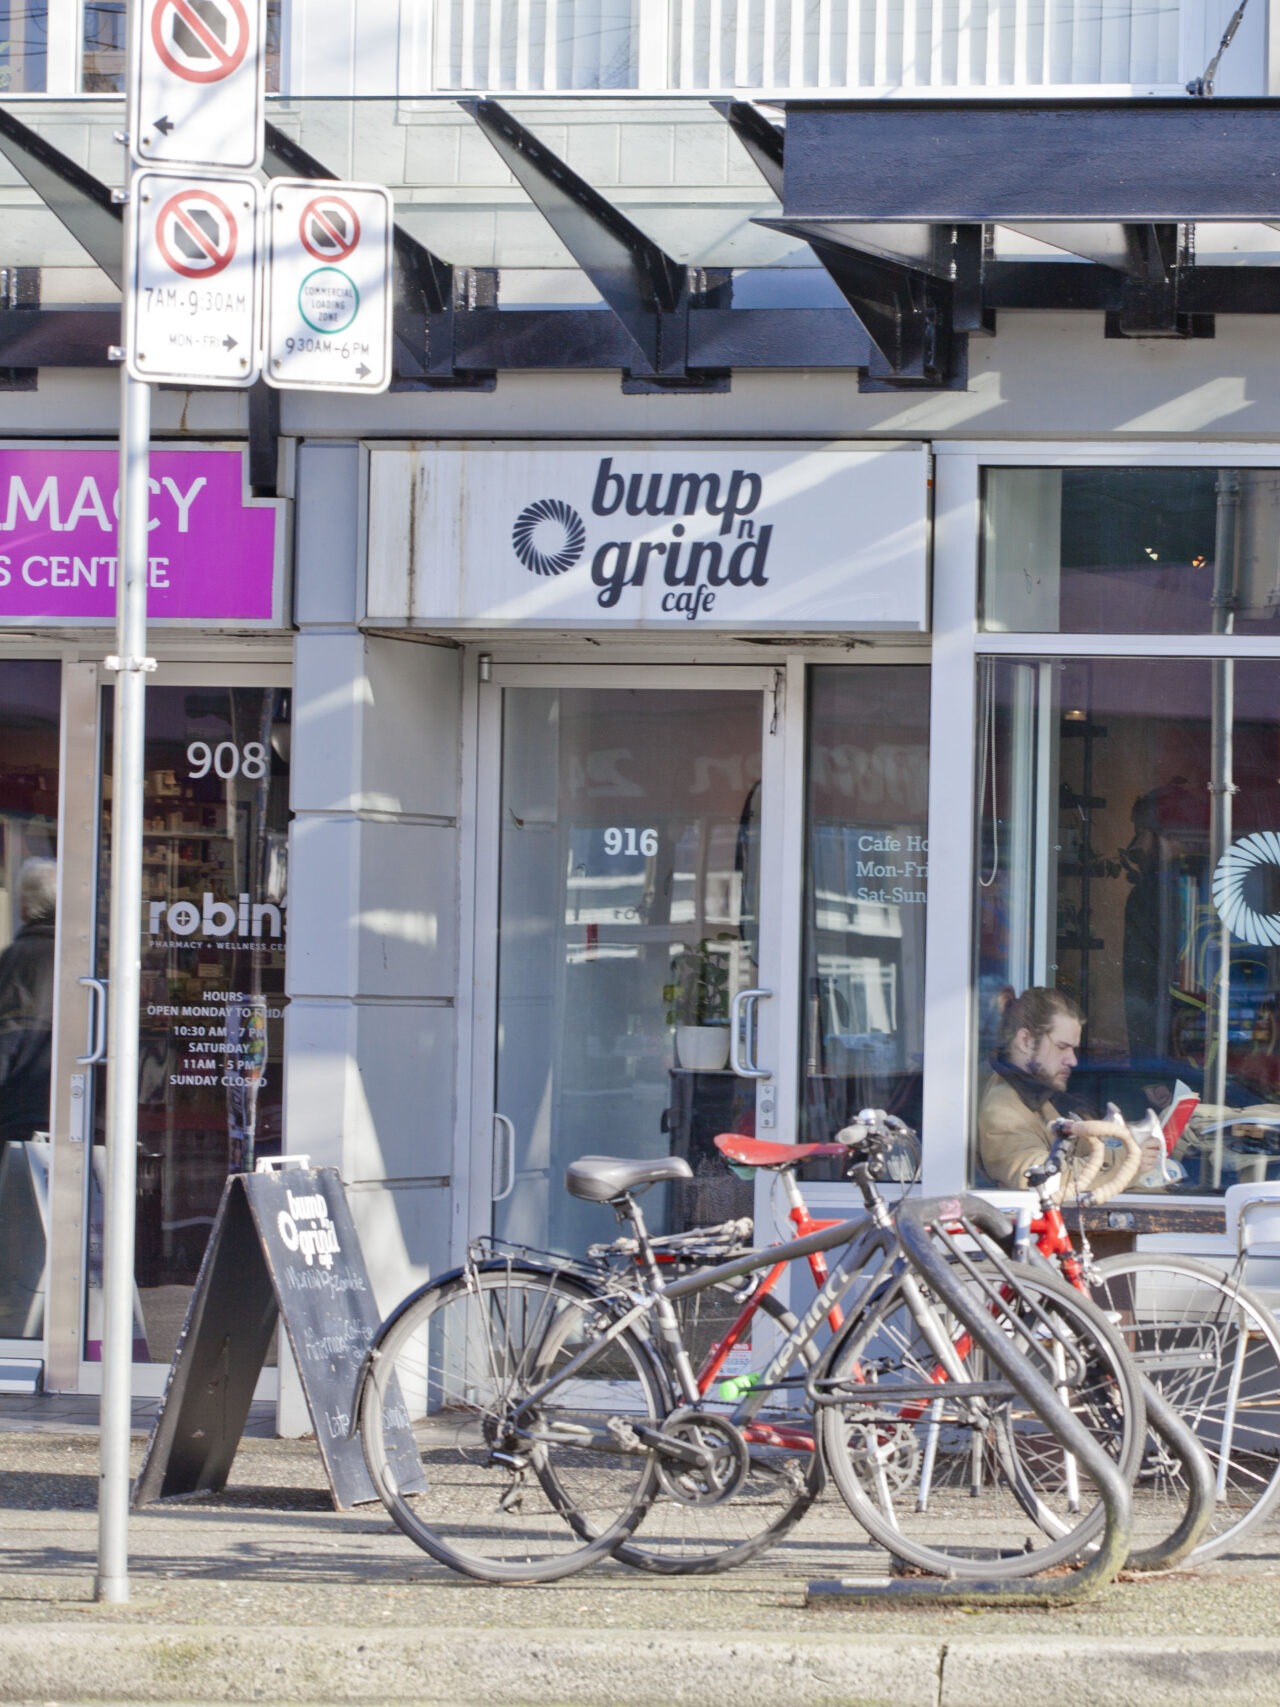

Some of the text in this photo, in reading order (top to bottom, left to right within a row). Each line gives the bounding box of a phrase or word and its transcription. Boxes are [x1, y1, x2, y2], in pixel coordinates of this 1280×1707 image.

[304, 286, 353, 298] COMMERCIAL
[311, 300, 346, 310] LOADING
[318, 312, 338, 322] ZONE
[591, 457, 763, 536] bump
[736, 519, 755, 540] n
[22, 555, 170, 588] CENTE
[591, 524, 774, 609] grind
[661, 584, 716, 621] cafe
[186, 741, 267, 780] 908
[604, 827, 659, 857] 916
[857, 836, 902, 852] Cafe
[149, 892, 287, 938] robin
[149, 941, 203, 949] PHARMACY
[216, 943, 267, 951] WELLNESS
[203, 991, 244, 1002] HOURS
[147, 1006, 179, 1016] OPEN
[182, 1006, 233, 1018] MONDAY
[235, 1008, 252, 1018] TO
[173, 1026, 206, 1036] 10:30
[208, 1027, 228, 1038] AM
[238, 1028, 246, 1036] 7
[188, 1042, 251, 1054] SATURDAY
[183, 1059, 217, 1070] 11AM
[227, 1060, 235, 1071] 5
[237, 1061, 256, 1072] PM
[169, 1074, 268, 1088] SUNDAY CLOSD
